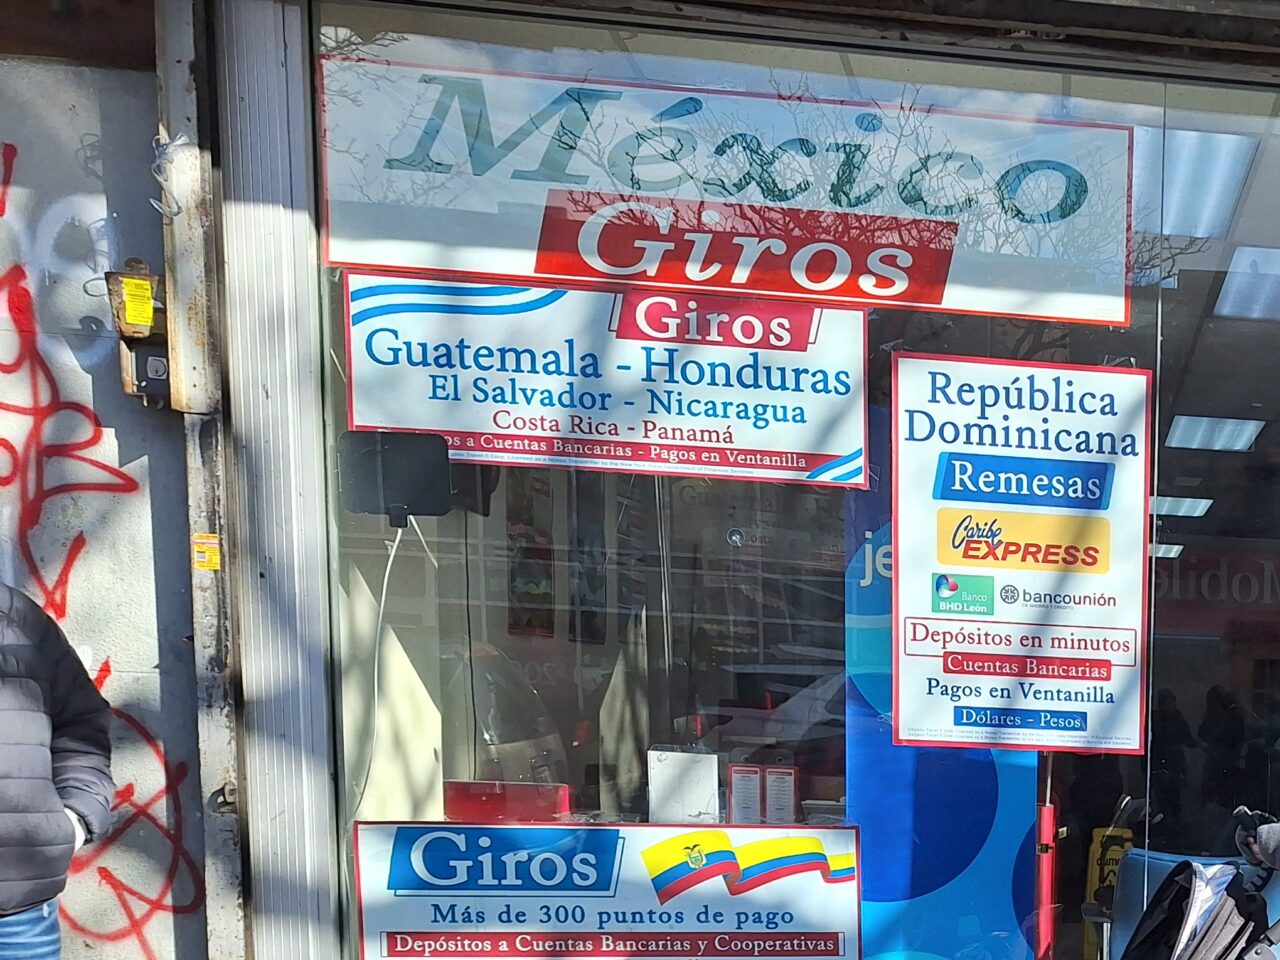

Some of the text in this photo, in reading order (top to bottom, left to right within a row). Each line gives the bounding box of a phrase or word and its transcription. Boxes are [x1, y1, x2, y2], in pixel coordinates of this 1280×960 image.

[383, 74, 1089, 224] México
[577, 201, 914, 296] Giros
[635, 296, 792, 347] Giros
[365, 327, 603, 379] Guatemala
[640, 346, 851, 396] Honduras
[428, 374, 461, 401] El
[472, 376, 612, 411] Salvador
[647, 388, 807, 430] Nicaragua
[927, 371, 1118, 420] República
[492, 410, 561, 433] Costa
[568, 414, 619, 437] Rica
[641, 420, 735, 444] Panamá
[904, 409, 1139, 457] Dominicana
[466, 438, 475, 447] a
[480, 435, 547, 451] Cuentas
[553, 440, 632, 457] Bancarias
[650, 445, 696, 462] Pagos
[701, 452, 720, 463] en
[725, 450, 807, 468] Ventanilla
[950, 459, 1101, 500] Remesas
[951, 515, 1003, 549] Caribe
[962, 539, 1100, 567] EXPRESS
[939, 601, 988, 613] BHD León
[961, 591, 988, 602] Banco
[1022, 588, 1117, 607] bancounión
[910, 622, 1130, 653] Depósitos en minutos
[947, 655, 1108, 679] Cuentas Bancarias
[926, 678, 1115, 704] Pagos en Ventanilla
[960, 709, 1022, 726] Dólares
[1039, 712, 1081, 728] Pesos
[410, 830, 598, 887] Giros
[430, 903, 795, 930] Más de 300 puntos de pago
[394, 934, 834, 956] Depósitos a Cuentas Bancarias y Cooperativas
